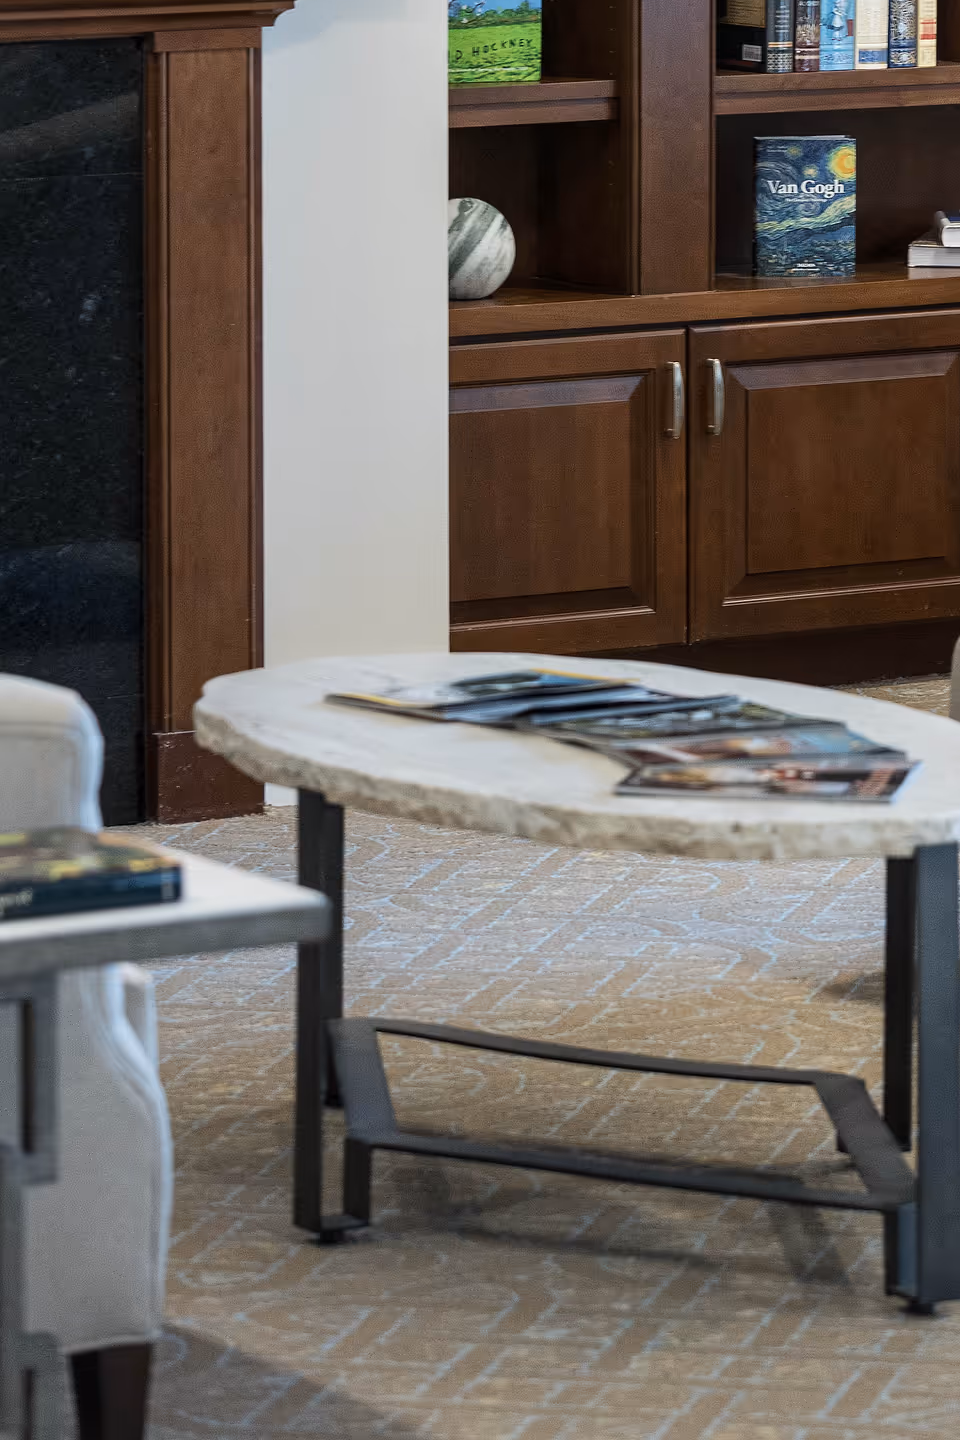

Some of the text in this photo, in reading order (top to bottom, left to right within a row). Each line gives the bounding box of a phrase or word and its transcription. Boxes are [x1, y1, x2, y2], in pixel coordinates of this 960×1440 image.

[471, 38, 534, 57] HOCKNEY
[767, 179, 845, 199] Van Gogh
